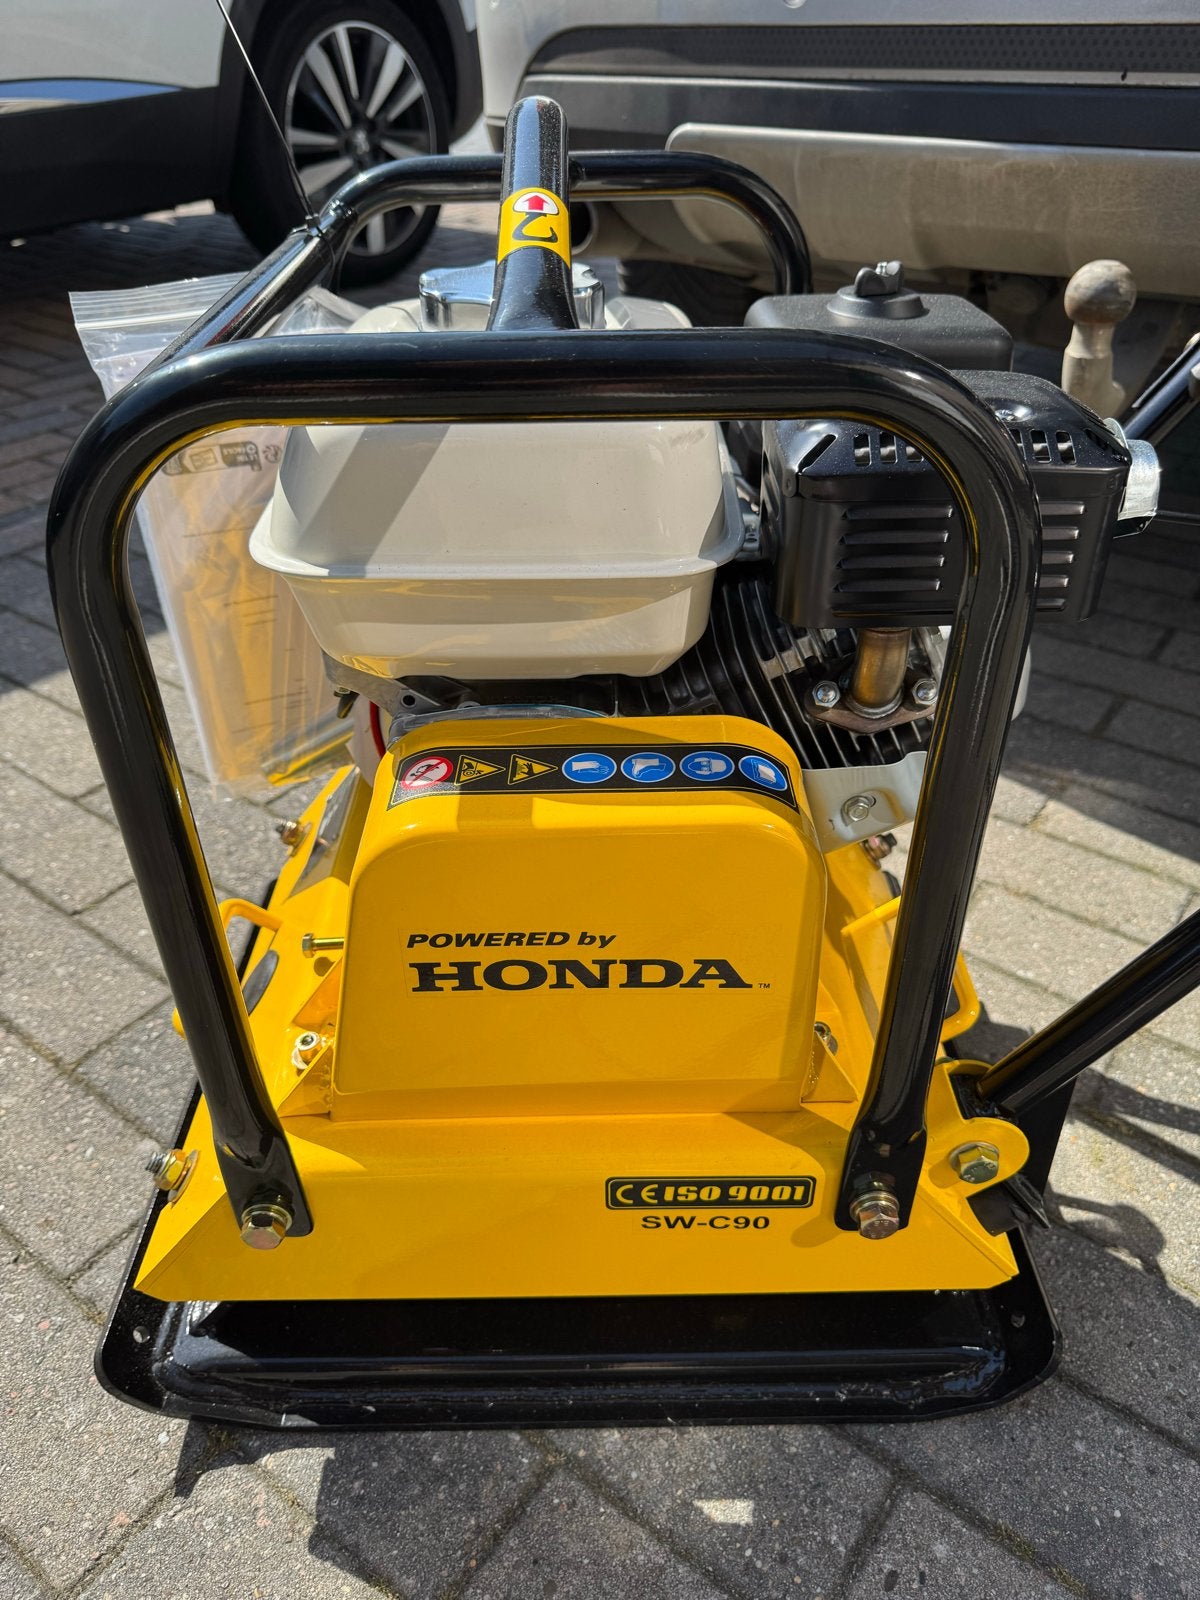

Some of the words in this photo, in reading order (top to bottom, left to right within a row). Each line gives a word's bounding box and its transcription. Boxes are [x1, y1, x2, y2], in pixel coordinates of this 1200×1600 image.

[406, 931, 570, 949] POWERED
[577, 931, 618, 949] by
[408, 959, 753, 993] HONDA
[615, 1183, 659, 1204] CE
[664, 1185, 721, 1202] ISO
[728, 1185, 805, 1201] 9001
[641, 1215, 770, 1230] SW-C90
